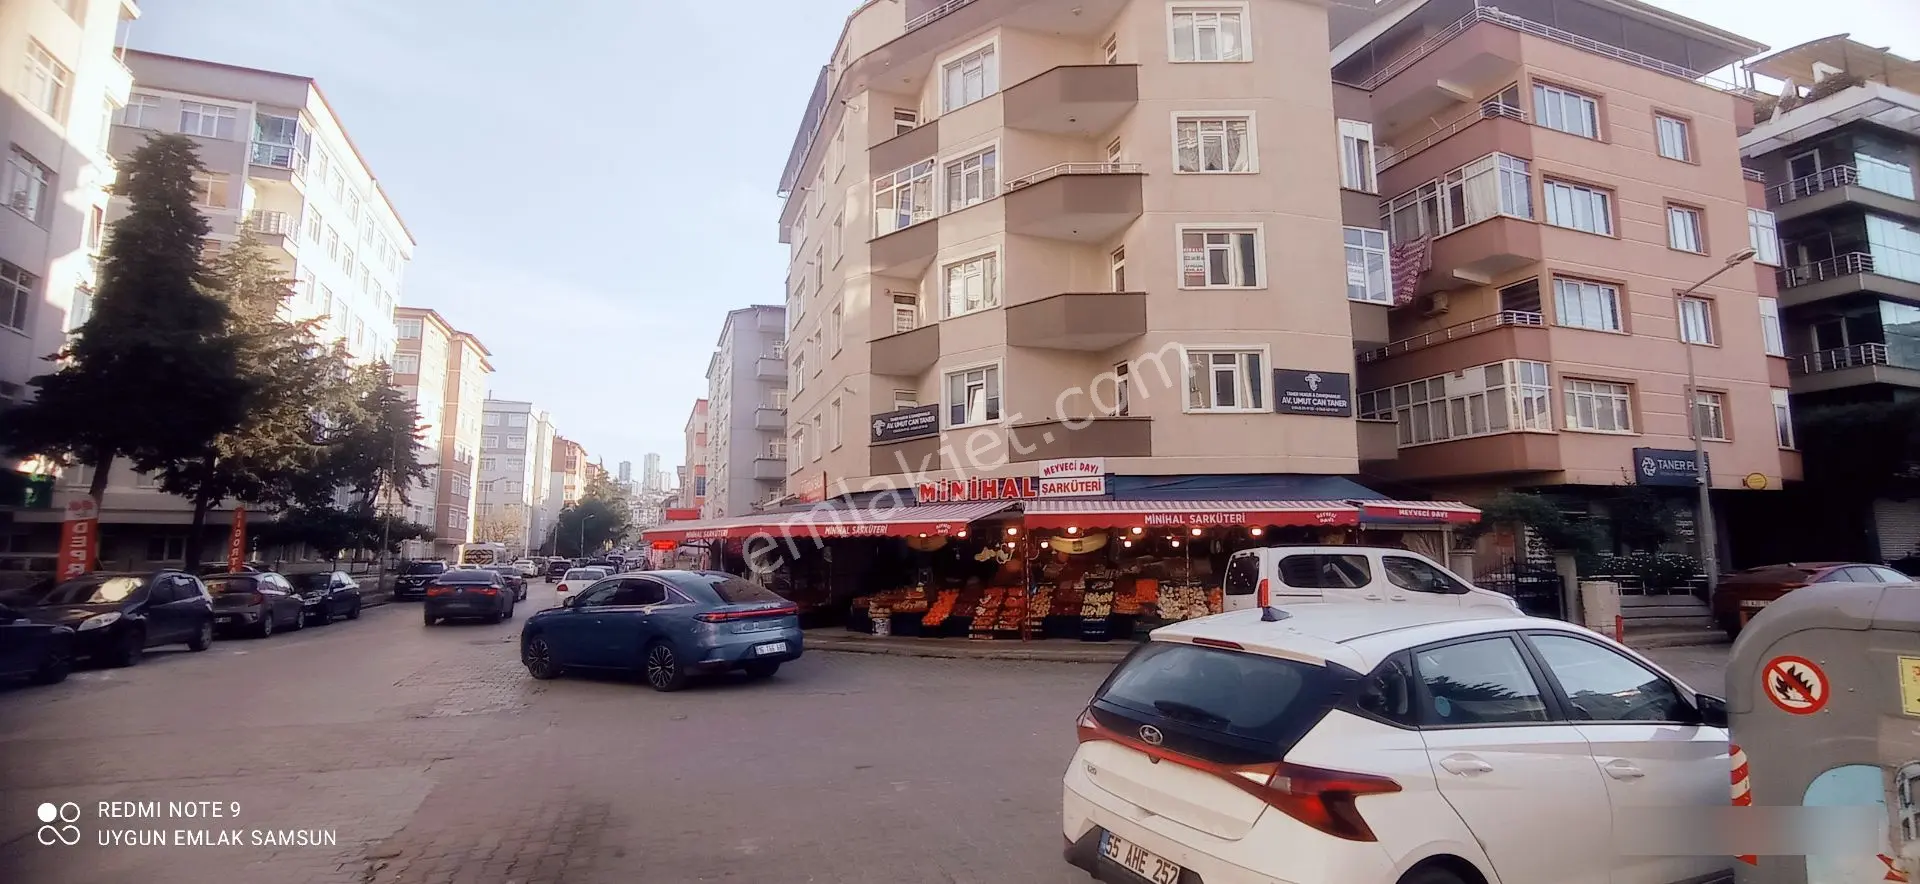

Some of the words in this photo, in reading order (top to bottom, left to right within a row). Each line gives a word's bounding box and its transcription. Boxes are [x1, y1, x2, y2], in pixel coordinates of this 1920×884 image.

[1294, 397, 1312, 405] UMUT
[1312, 398, 1326, 406] CAN
[1327, 400, 1348, 408] TANER
[1043, 460, 1077, 477] MEYVECİ
[1079, 462, 1099, 475] DAYI
[1657, 459, 1686, 471] TANER
[1687, 461, 1708, 472] PLS
[918, 475, 1037, 503] MİNİHAL
[1041, 479, 1101, 495] ŞARKÜTERİ
[1144, 513, 1186, 525] MİNİHAL
[1189, 512, 1246, 524] SARKÜTERİ
[1105, 835, 1121, 859] 55
[1125, 844, 1149, 874] AHE
[1153, 859, 1179, 884] 252
